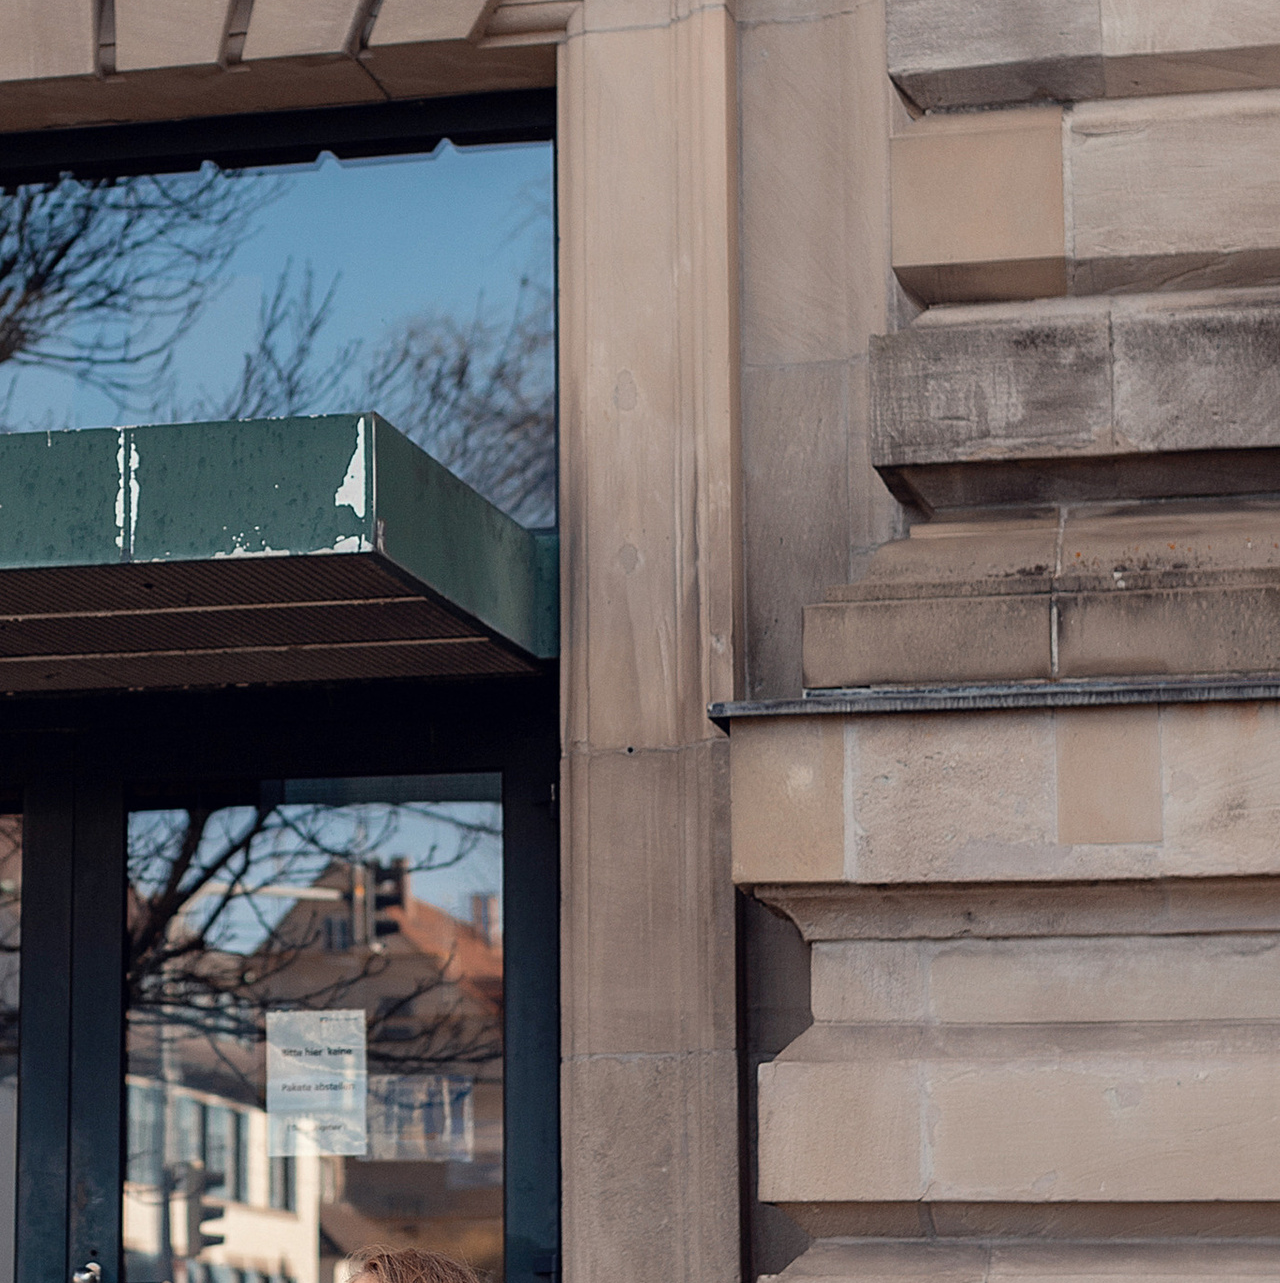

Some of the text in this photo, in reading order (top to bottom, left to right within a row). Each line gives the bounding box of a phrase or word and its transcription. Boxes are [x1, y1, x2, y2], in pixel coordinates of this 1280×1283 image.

[304, 1047, 322, 1056] hier
[326, 1047, 352, 1056] keine
[281, 1083, 312, 1092] Pakete
